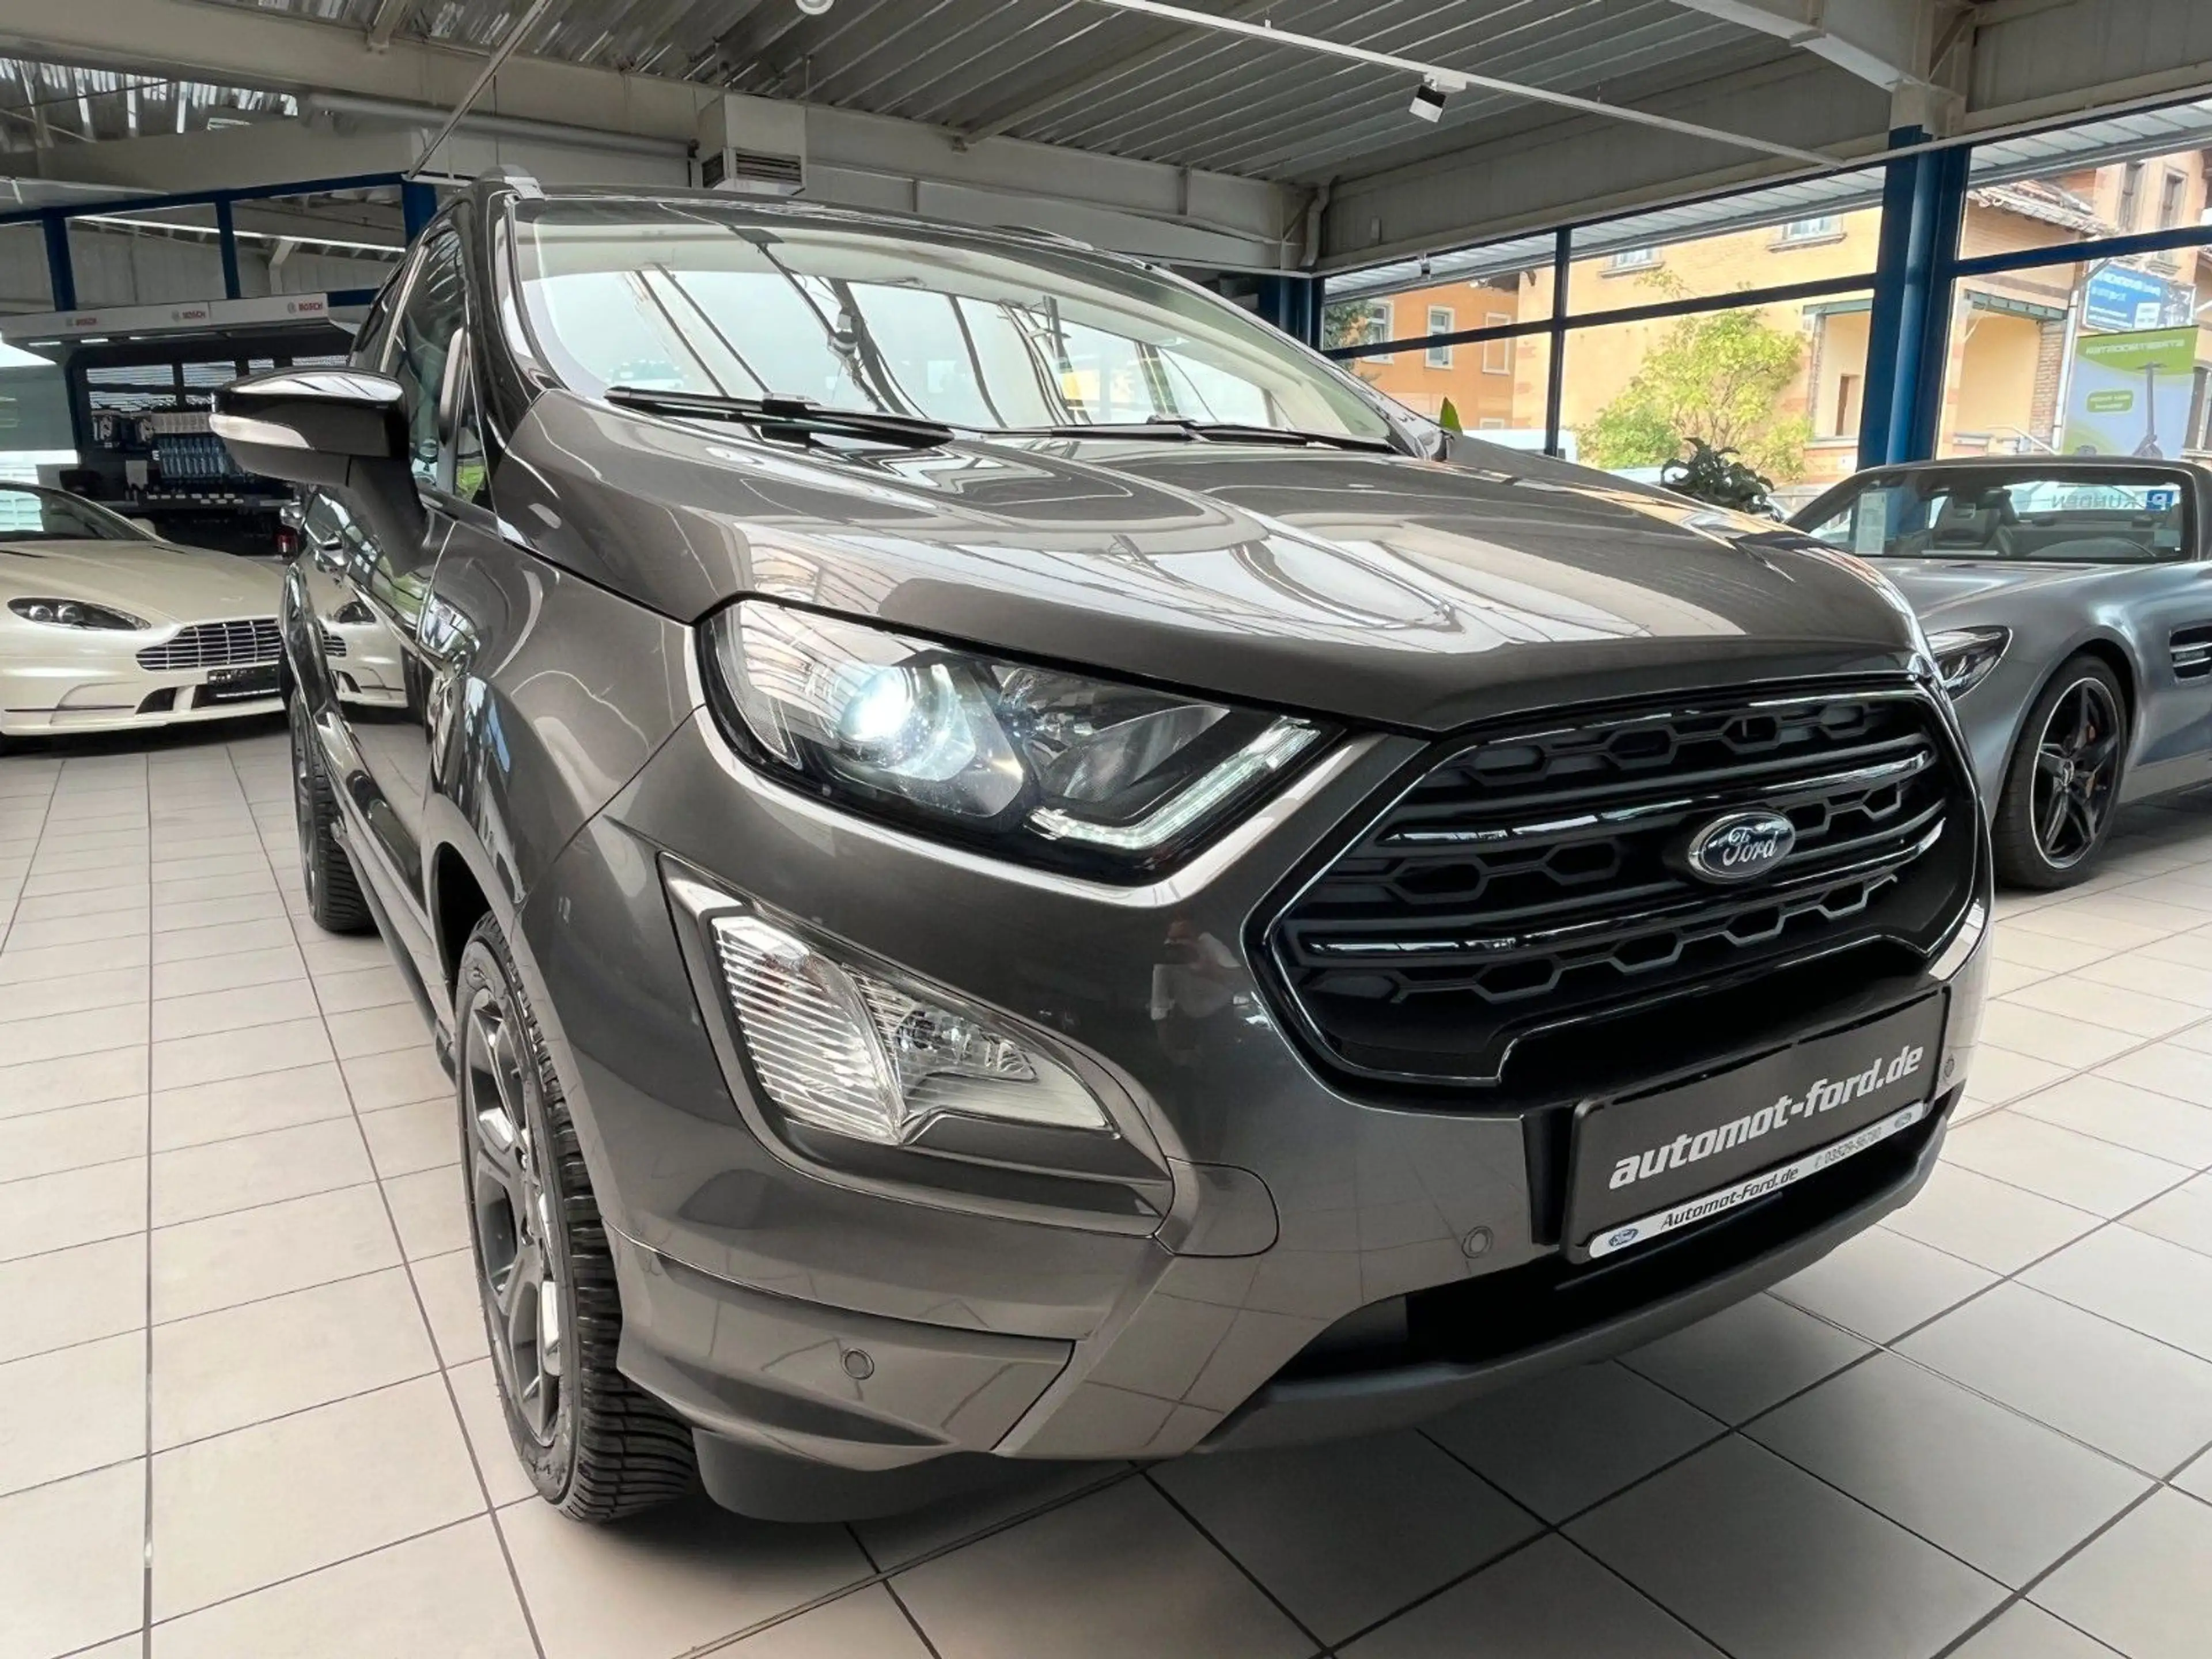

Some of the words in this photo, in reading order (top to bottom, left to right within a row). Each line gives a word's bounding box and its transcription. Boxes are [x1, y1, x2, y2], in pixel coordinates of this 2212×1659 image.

[298, 302, 323, 311] BOSCH
[1722, 825, 1778, 866] Ford
[1609, 1045, 1923, 1189] automot-ford.de
[1661, 1166, 1799, 1230] Automot-Ford.de
